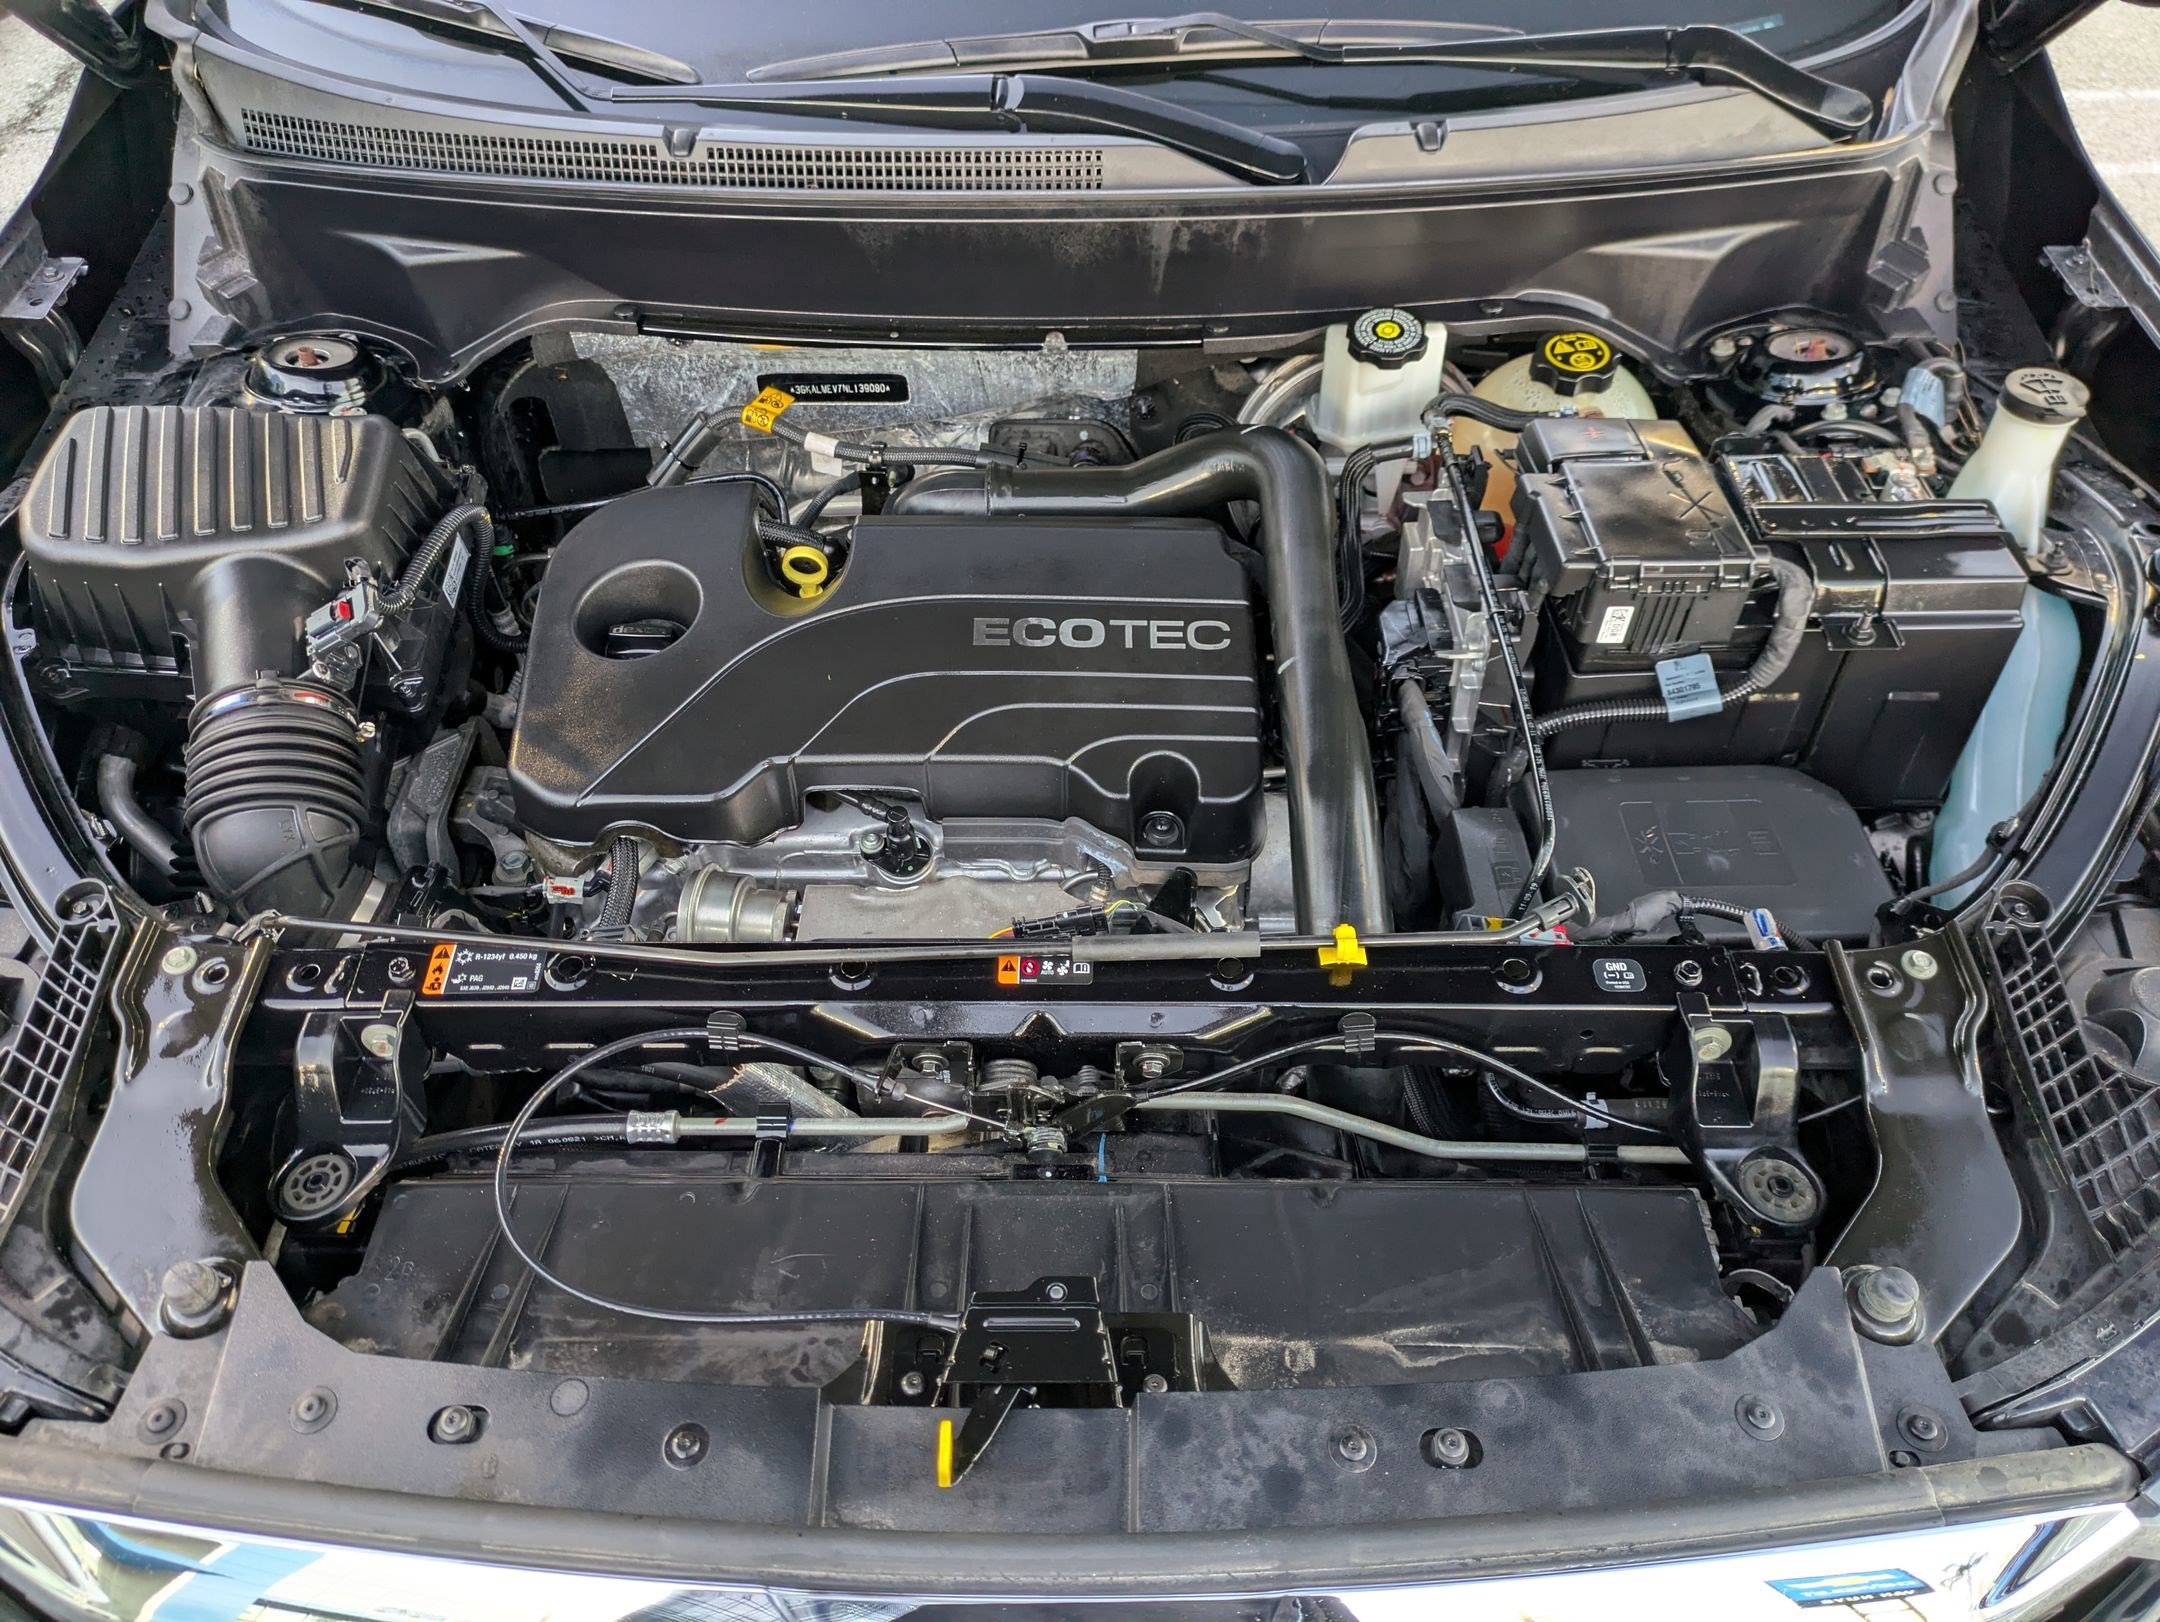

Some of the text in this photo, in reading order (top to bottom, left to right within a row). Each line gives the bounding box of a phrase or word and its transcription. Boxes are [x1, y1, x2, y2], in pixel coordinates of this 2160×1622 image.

[973, 617, 1231, 650] ECOTEC
[475, 952, 538, 962] R-1234yf 0.450 kg
[1605, 962, 1627, 971] GND
[468, 974, 484, 982] PAG
